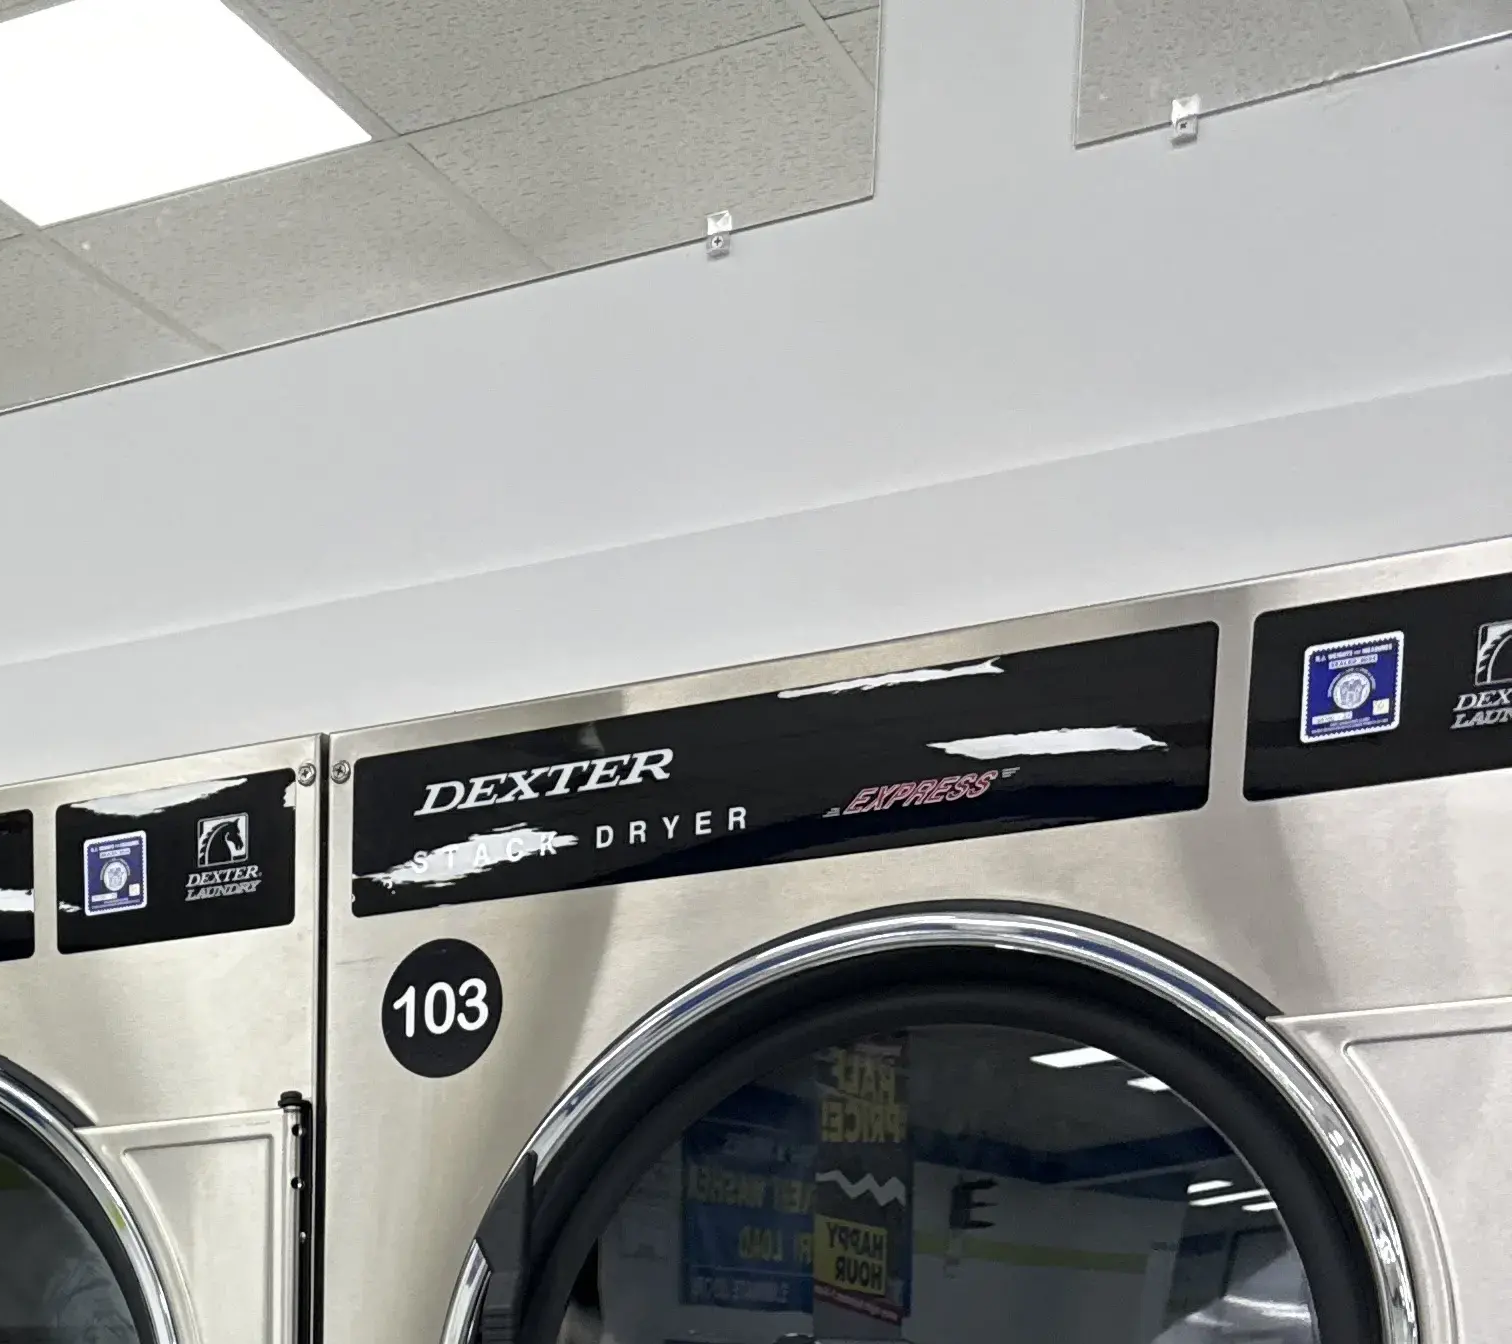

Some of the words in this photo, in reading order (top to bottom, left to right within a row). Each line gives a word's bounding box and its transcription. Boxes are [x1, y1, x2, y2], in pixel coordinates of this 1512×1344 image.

[414, 747, 675, 817] DEXTER
[843, 769, 999, 815] EXPRESS
[411, 833, 559, 876] STACK
[595, 806, 748, 849] DRYER
[184, 879, 262, 902] LAUNDRY
[185, 864, 261, 888] DEXTER
[392, 976, 489, 1038] 103
